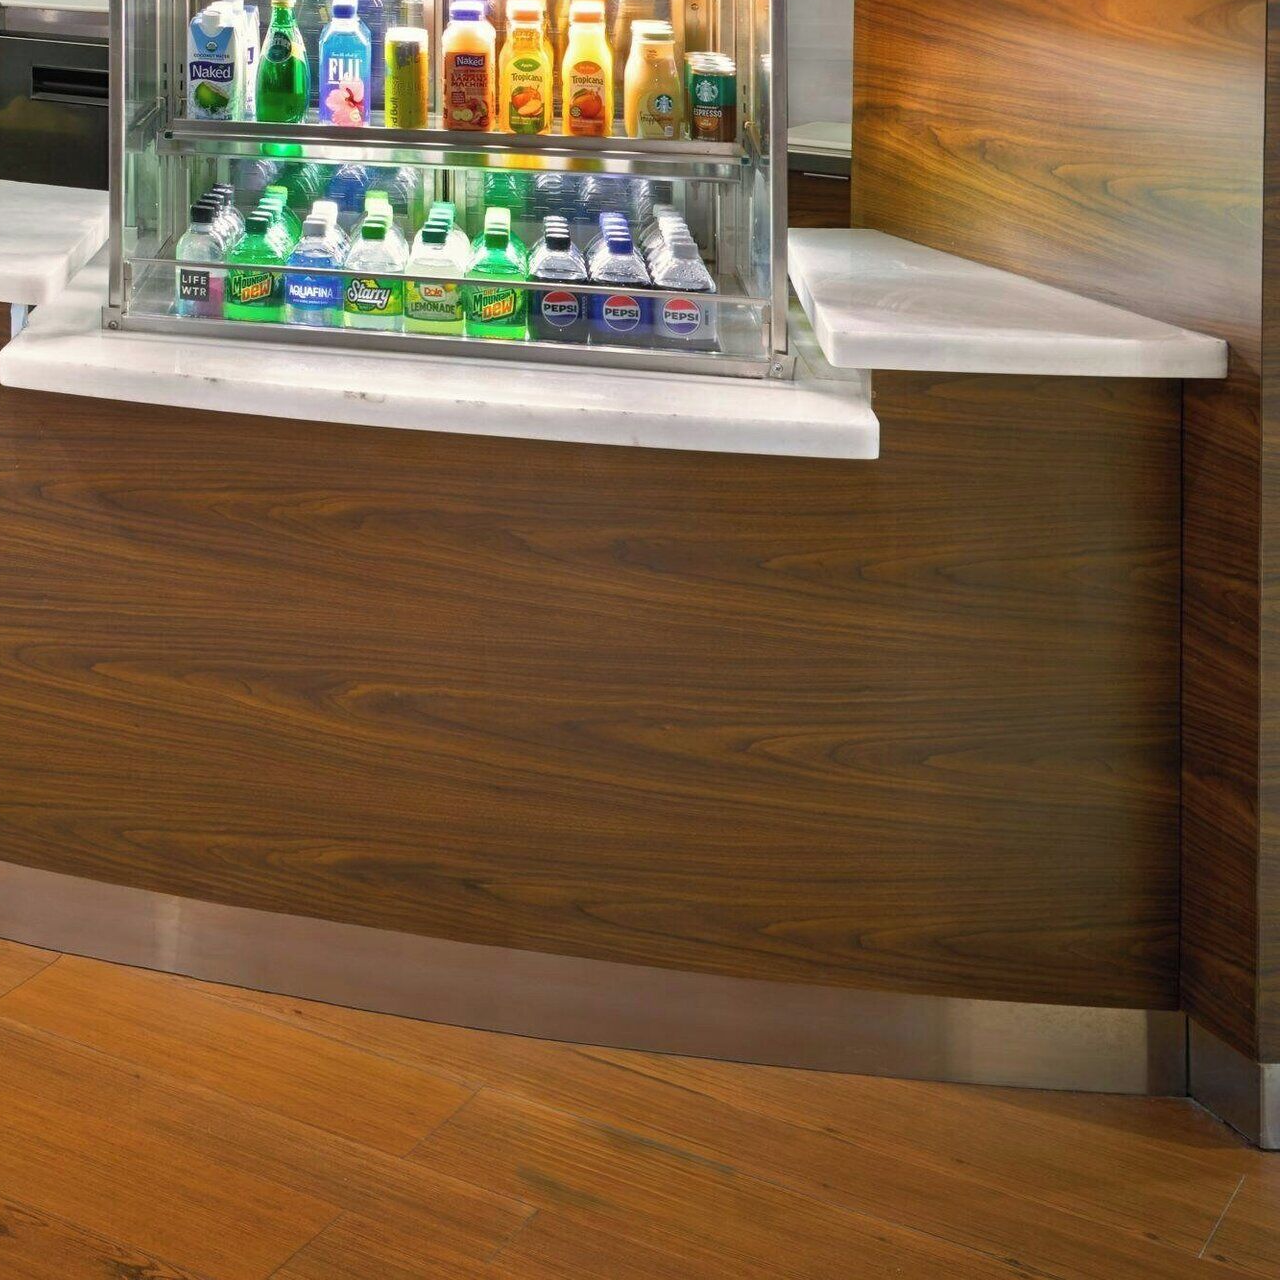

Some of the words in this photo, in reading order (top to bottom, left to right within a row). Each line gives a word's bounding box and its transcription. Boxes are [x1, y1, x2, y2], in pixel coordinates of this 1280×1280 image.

[456, 56, 483, 67] Naked
[192, 64, 231, 79] Naked
[328, 58, 362, 81] FIJI
[511, 73, 543, 83] Tropicana
[572, 76, 604, 85] Tropicana
[182, 275, 207, 285] LIFE
[182, 286, 207, 297] WTR
[289, 284, 333, 298] AQUAFINA
[347, 279, 391, 308] Starry
[424, 287, 443, 297] Dole
[411, 302, 456, 313] LEMONADE
[544, 303, 577, 313] PEPSI
[605, 307, 639, 317] PEPSI
[665, 311, 699, 321] PEPSI
